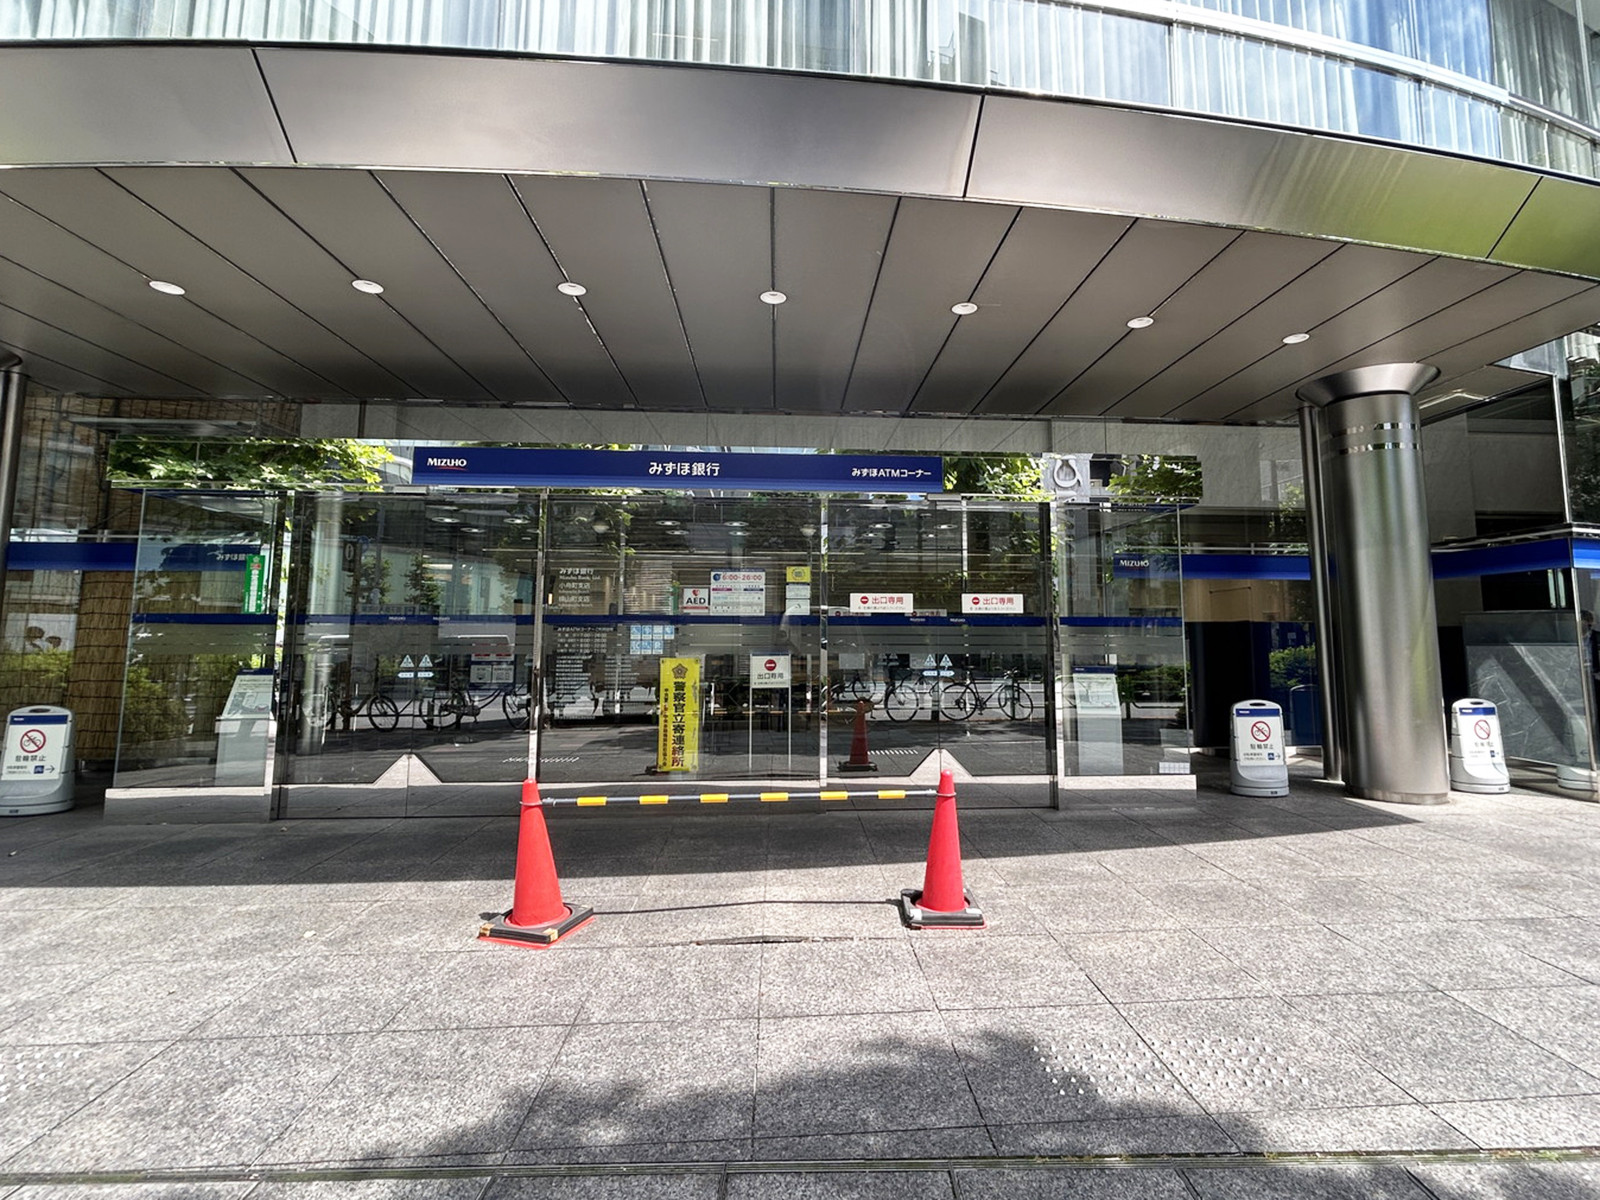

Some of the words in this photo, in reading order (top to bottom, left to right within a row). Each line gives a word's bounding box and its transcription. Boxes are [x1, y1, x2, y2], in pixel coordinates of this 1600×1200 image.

[426, 457, 468, 467] MIZUHO
[648, 461, 720, 477] みずほ銀行
[851, 462, 932, 478] みずほATMコーナー
[1119, 558, 1150, 567] MIZUHO
[685, 597, 706, 605] AED
[871, 596, 904, 605] 出口専用
[982, 597, 1015, 605] 出口専用
[757, 672, 784, 680] 出口専用
[671, 681, 687, 767] 警察官立寄連絡所
